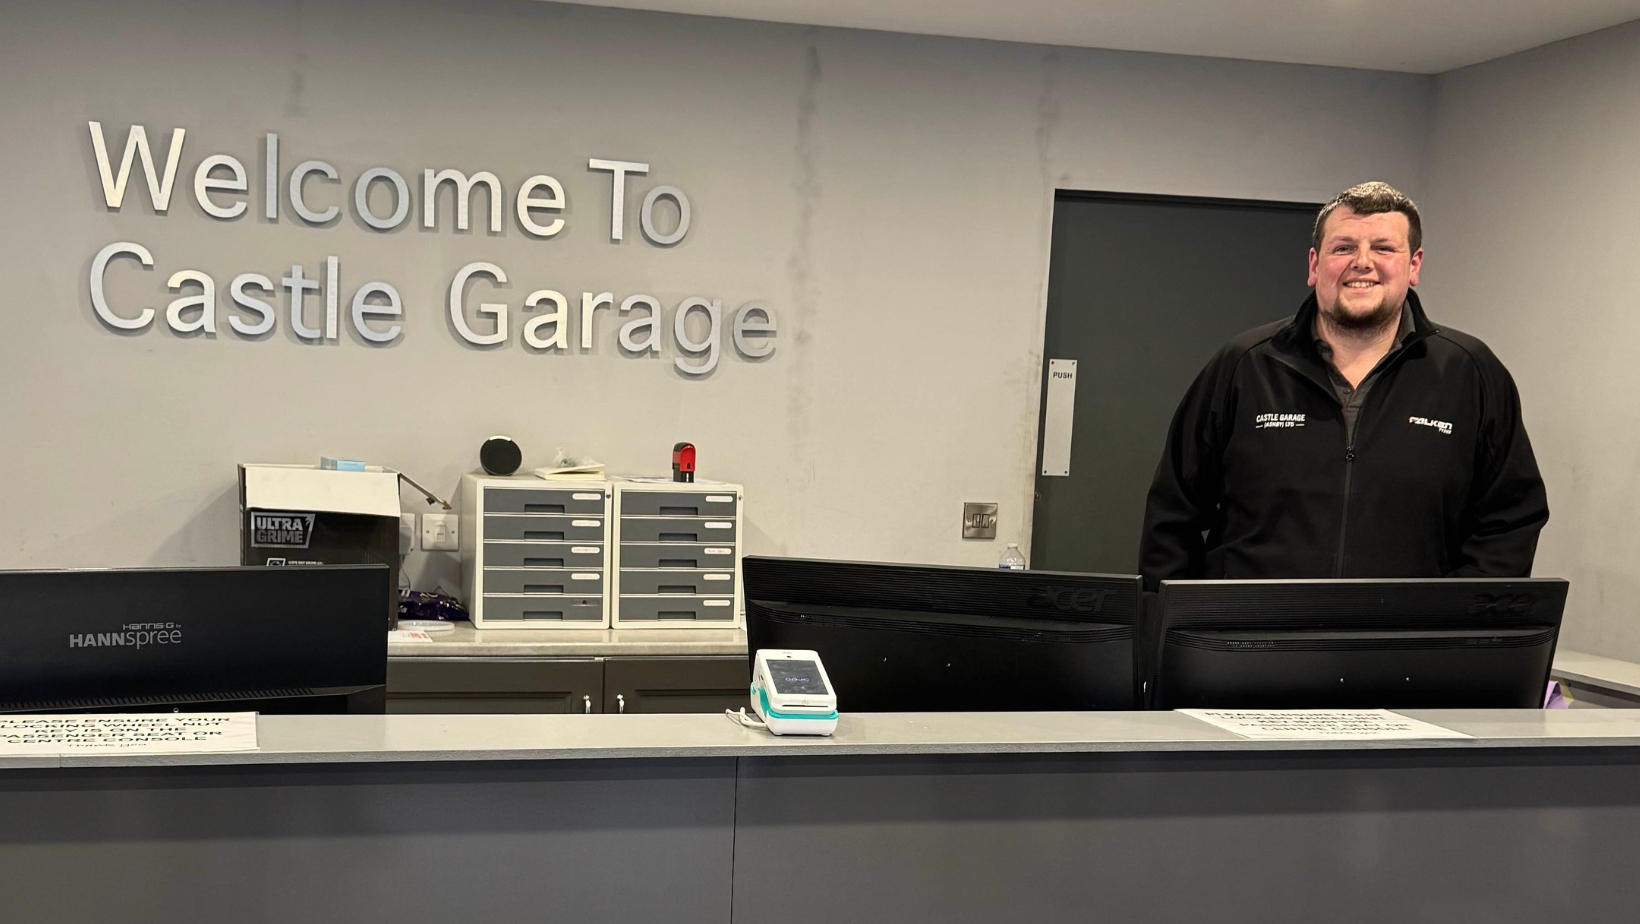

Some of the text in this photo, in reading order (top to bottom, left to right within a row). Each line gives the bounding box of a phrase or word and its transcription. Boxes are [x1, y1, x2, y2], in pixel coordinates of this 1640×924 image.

[88, 120, 692, 247] Welcome To
[89, 241, 778, 375] Castle Garage
[1052, 371, 1073, 379] PUSH
[1256, 413, 1306, 423] CASTLE GARAGE
[256, 516, 303, 531] ULTRA
[256, 530, 304, 544] GRIME
